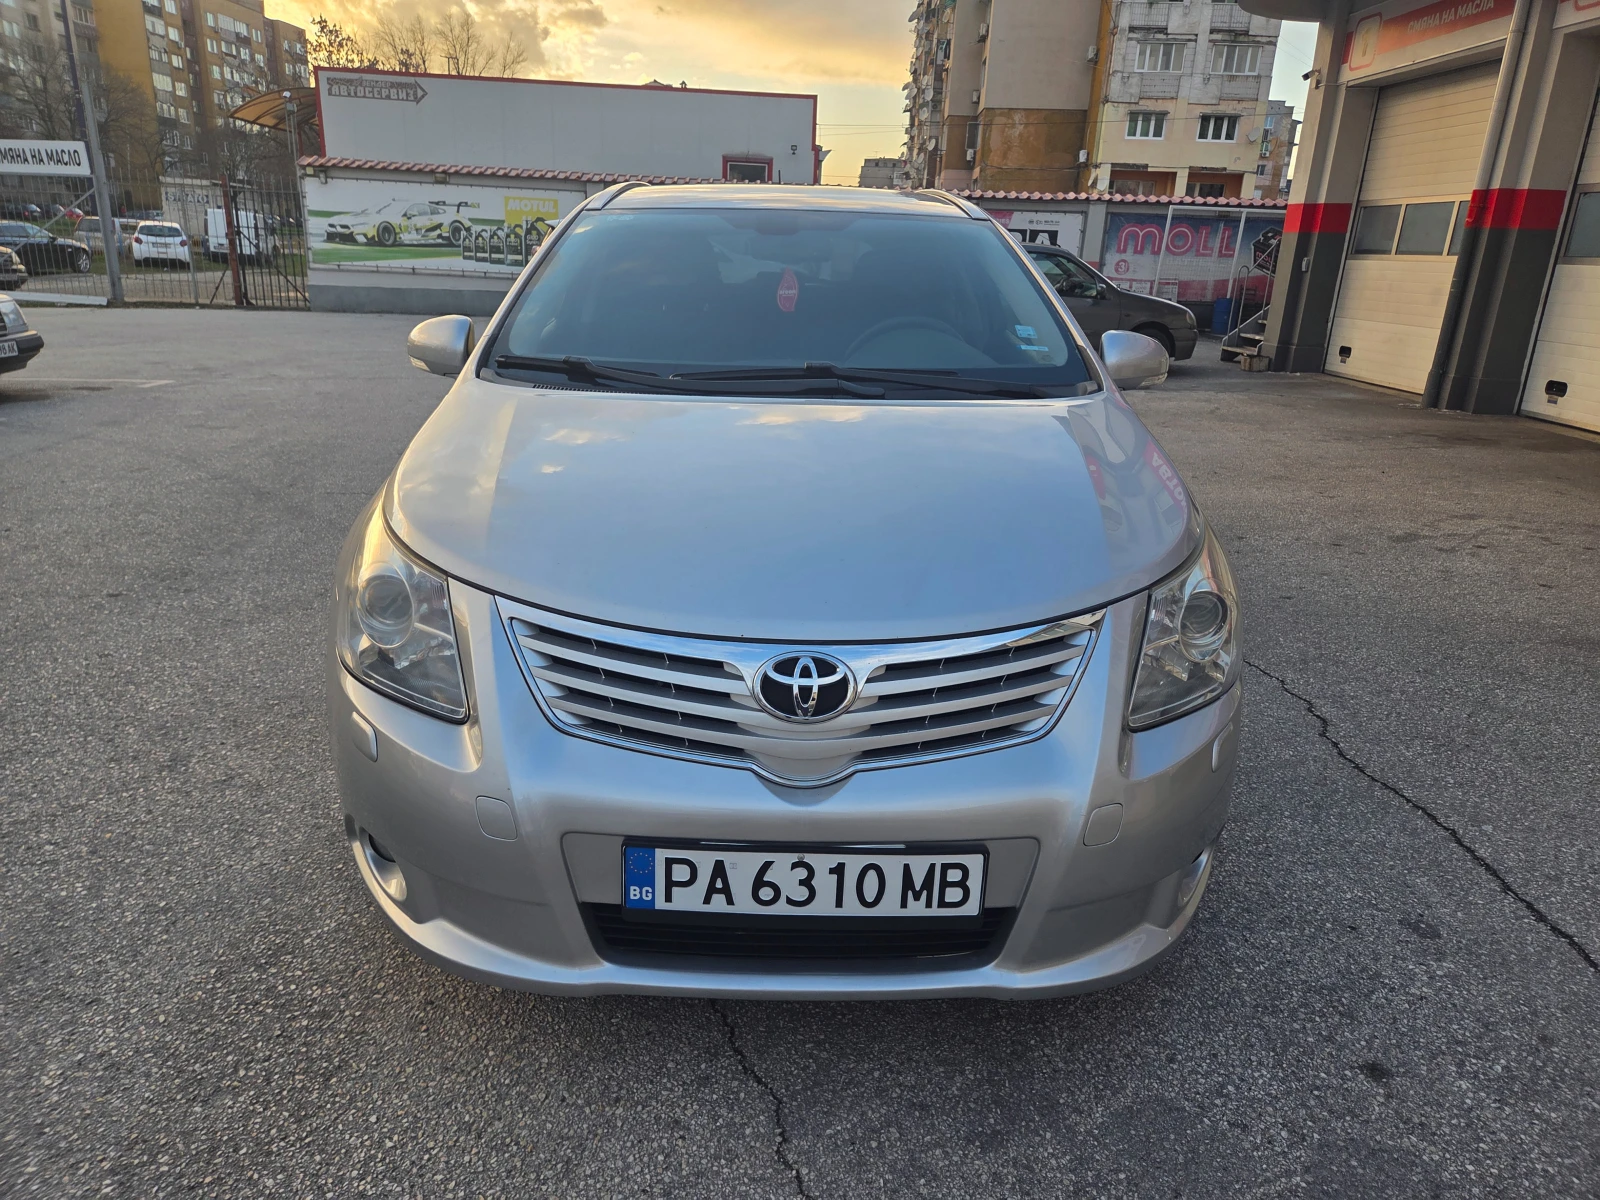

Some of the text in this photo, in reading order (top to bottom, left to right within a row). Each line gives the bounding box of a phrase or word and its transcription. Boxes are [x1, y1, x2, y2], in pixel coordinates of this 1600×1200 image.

[1407, 0, 1494, 33] СМЯНА НА МАСЛА
[331, 85, 415, 100] АВТОСЕРВИЗ
[29, 148, 46, 165] НА
[45, 148, 82, 167] МАСЛО
[507, 199, 556, 213] MOTUL
[663, 856, 971, 908] PA 6310 MB
[629, 885, 653, 900] BG
